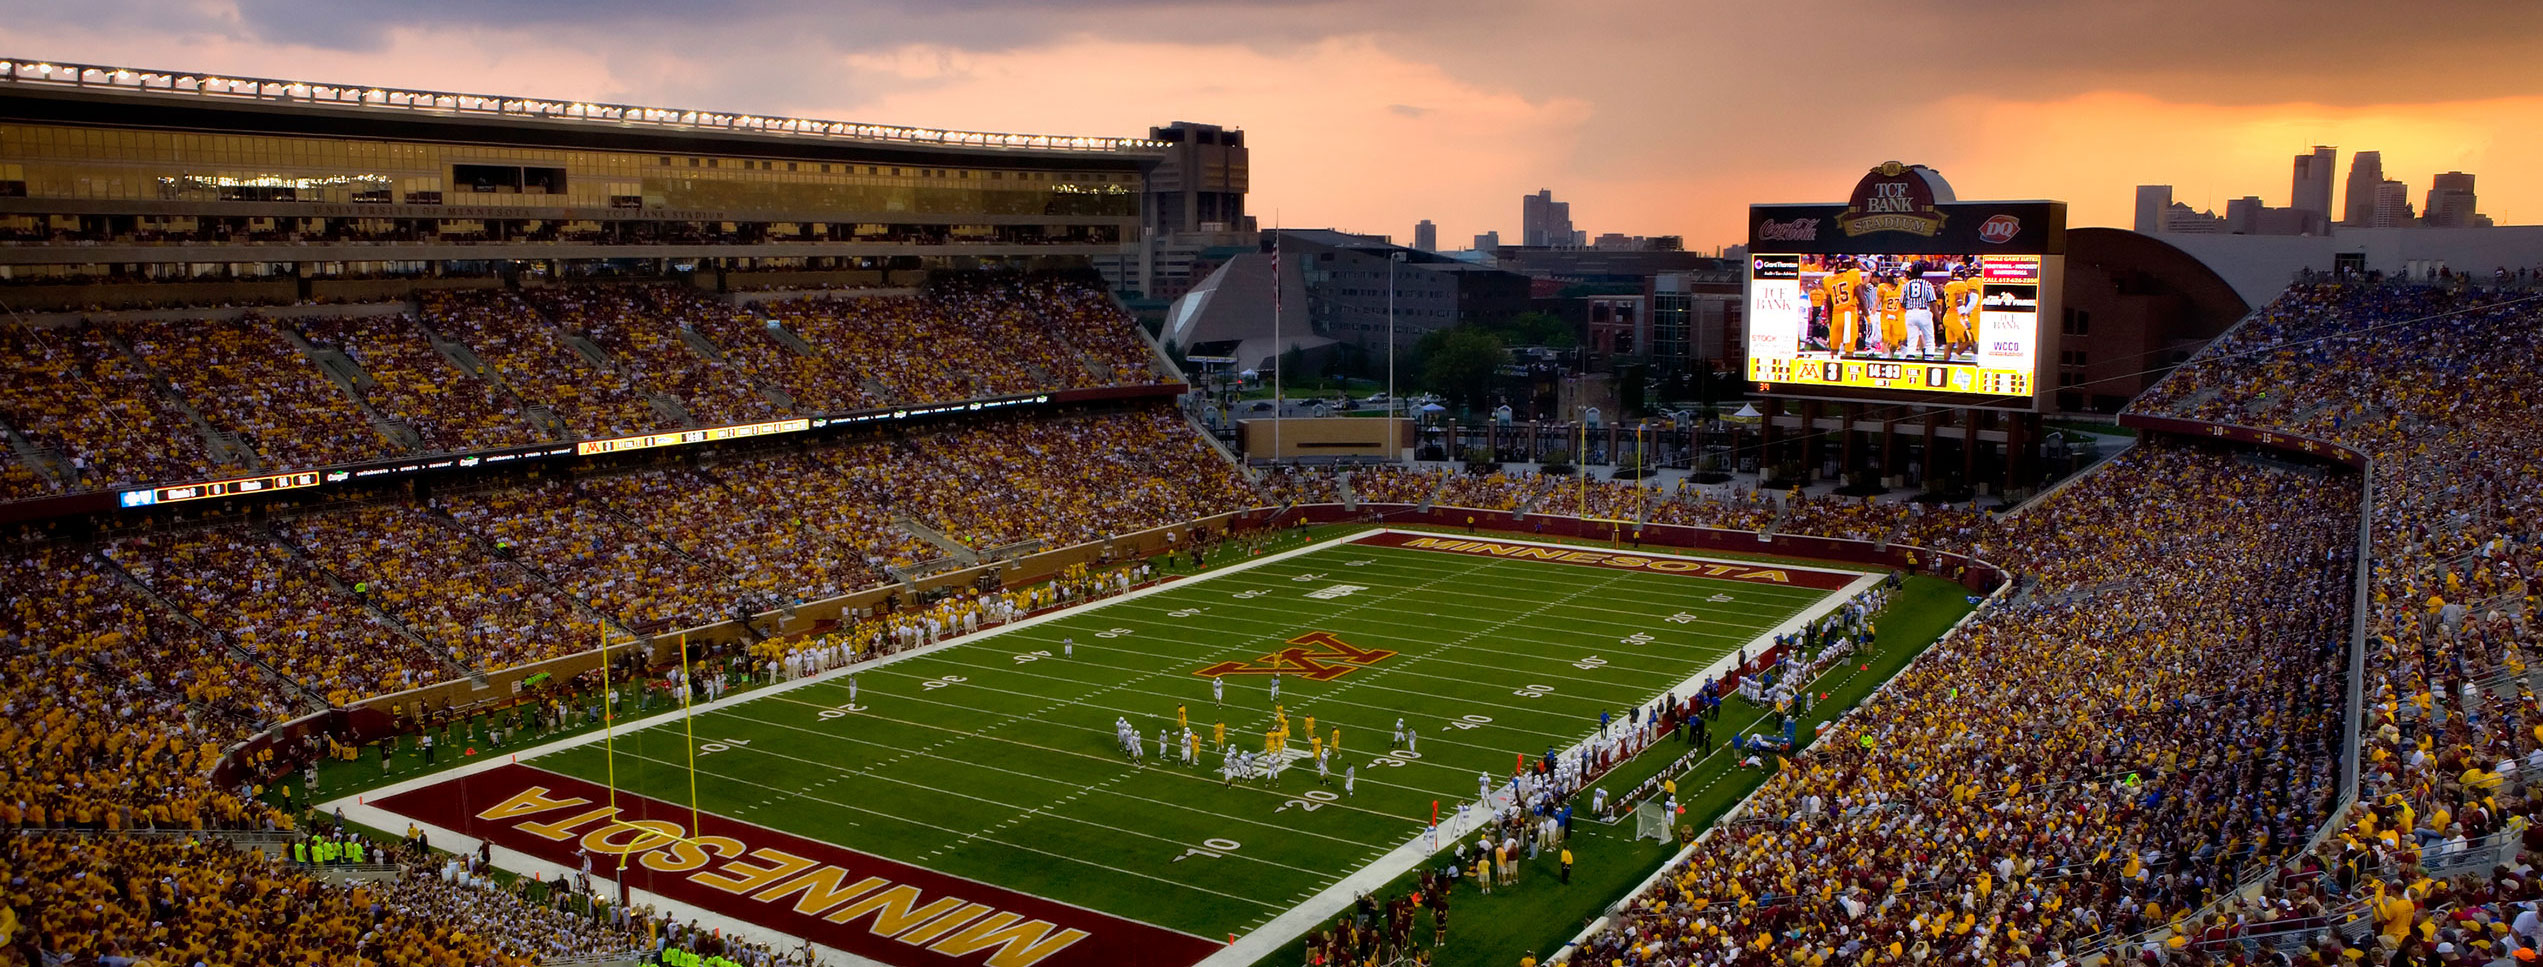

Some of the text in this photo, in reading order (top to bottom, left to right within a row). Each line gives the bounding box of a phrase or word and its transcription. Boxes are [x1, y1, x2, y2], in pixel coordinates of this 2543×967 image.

[1874, 182, 1909, 198] TCF
[314, 206, 531, 217] UNIVERSITY OF MINNESOTA
[1866, 197, 1914, 213] BANK
[672, 211, 724, 219] STADIUM
[1759, 218, 1820, 241] Coca-Cola
[1853, 217, 1926, 232] STADIUM
[1986, 221, 2014, 237] DQ
[1831, 282, 1849, 305] 15
[1886, 298, 1900, 311] 27
[1993, 341, 2019, 351] WCCO
[2213, 425, 2224, 436] 10
[2262, 432, 2272, 444] 15
[1401, 537, 1790, 583] MINNESOTA
[1620, 633, 1655, 646] 30
[1017, 649, 1053, 663] 40
[1192, 631, 1400, 682] M
[1573, 656, 1608, 670] 40
[927, 675, 967, 689] 30
[1513, 684, 1555, 698] 50
[822, 702, 868, 719] 20
[1452, 714, 1493, 731] 40
[703, 737, 751, 753] 10
[1375, 750, 1422, 767] 30
[1287, 790, 1339, 812] 20
[1187, 838, 1241, 859] 10
[475, 785, 1092, 967] MINNESOTA
